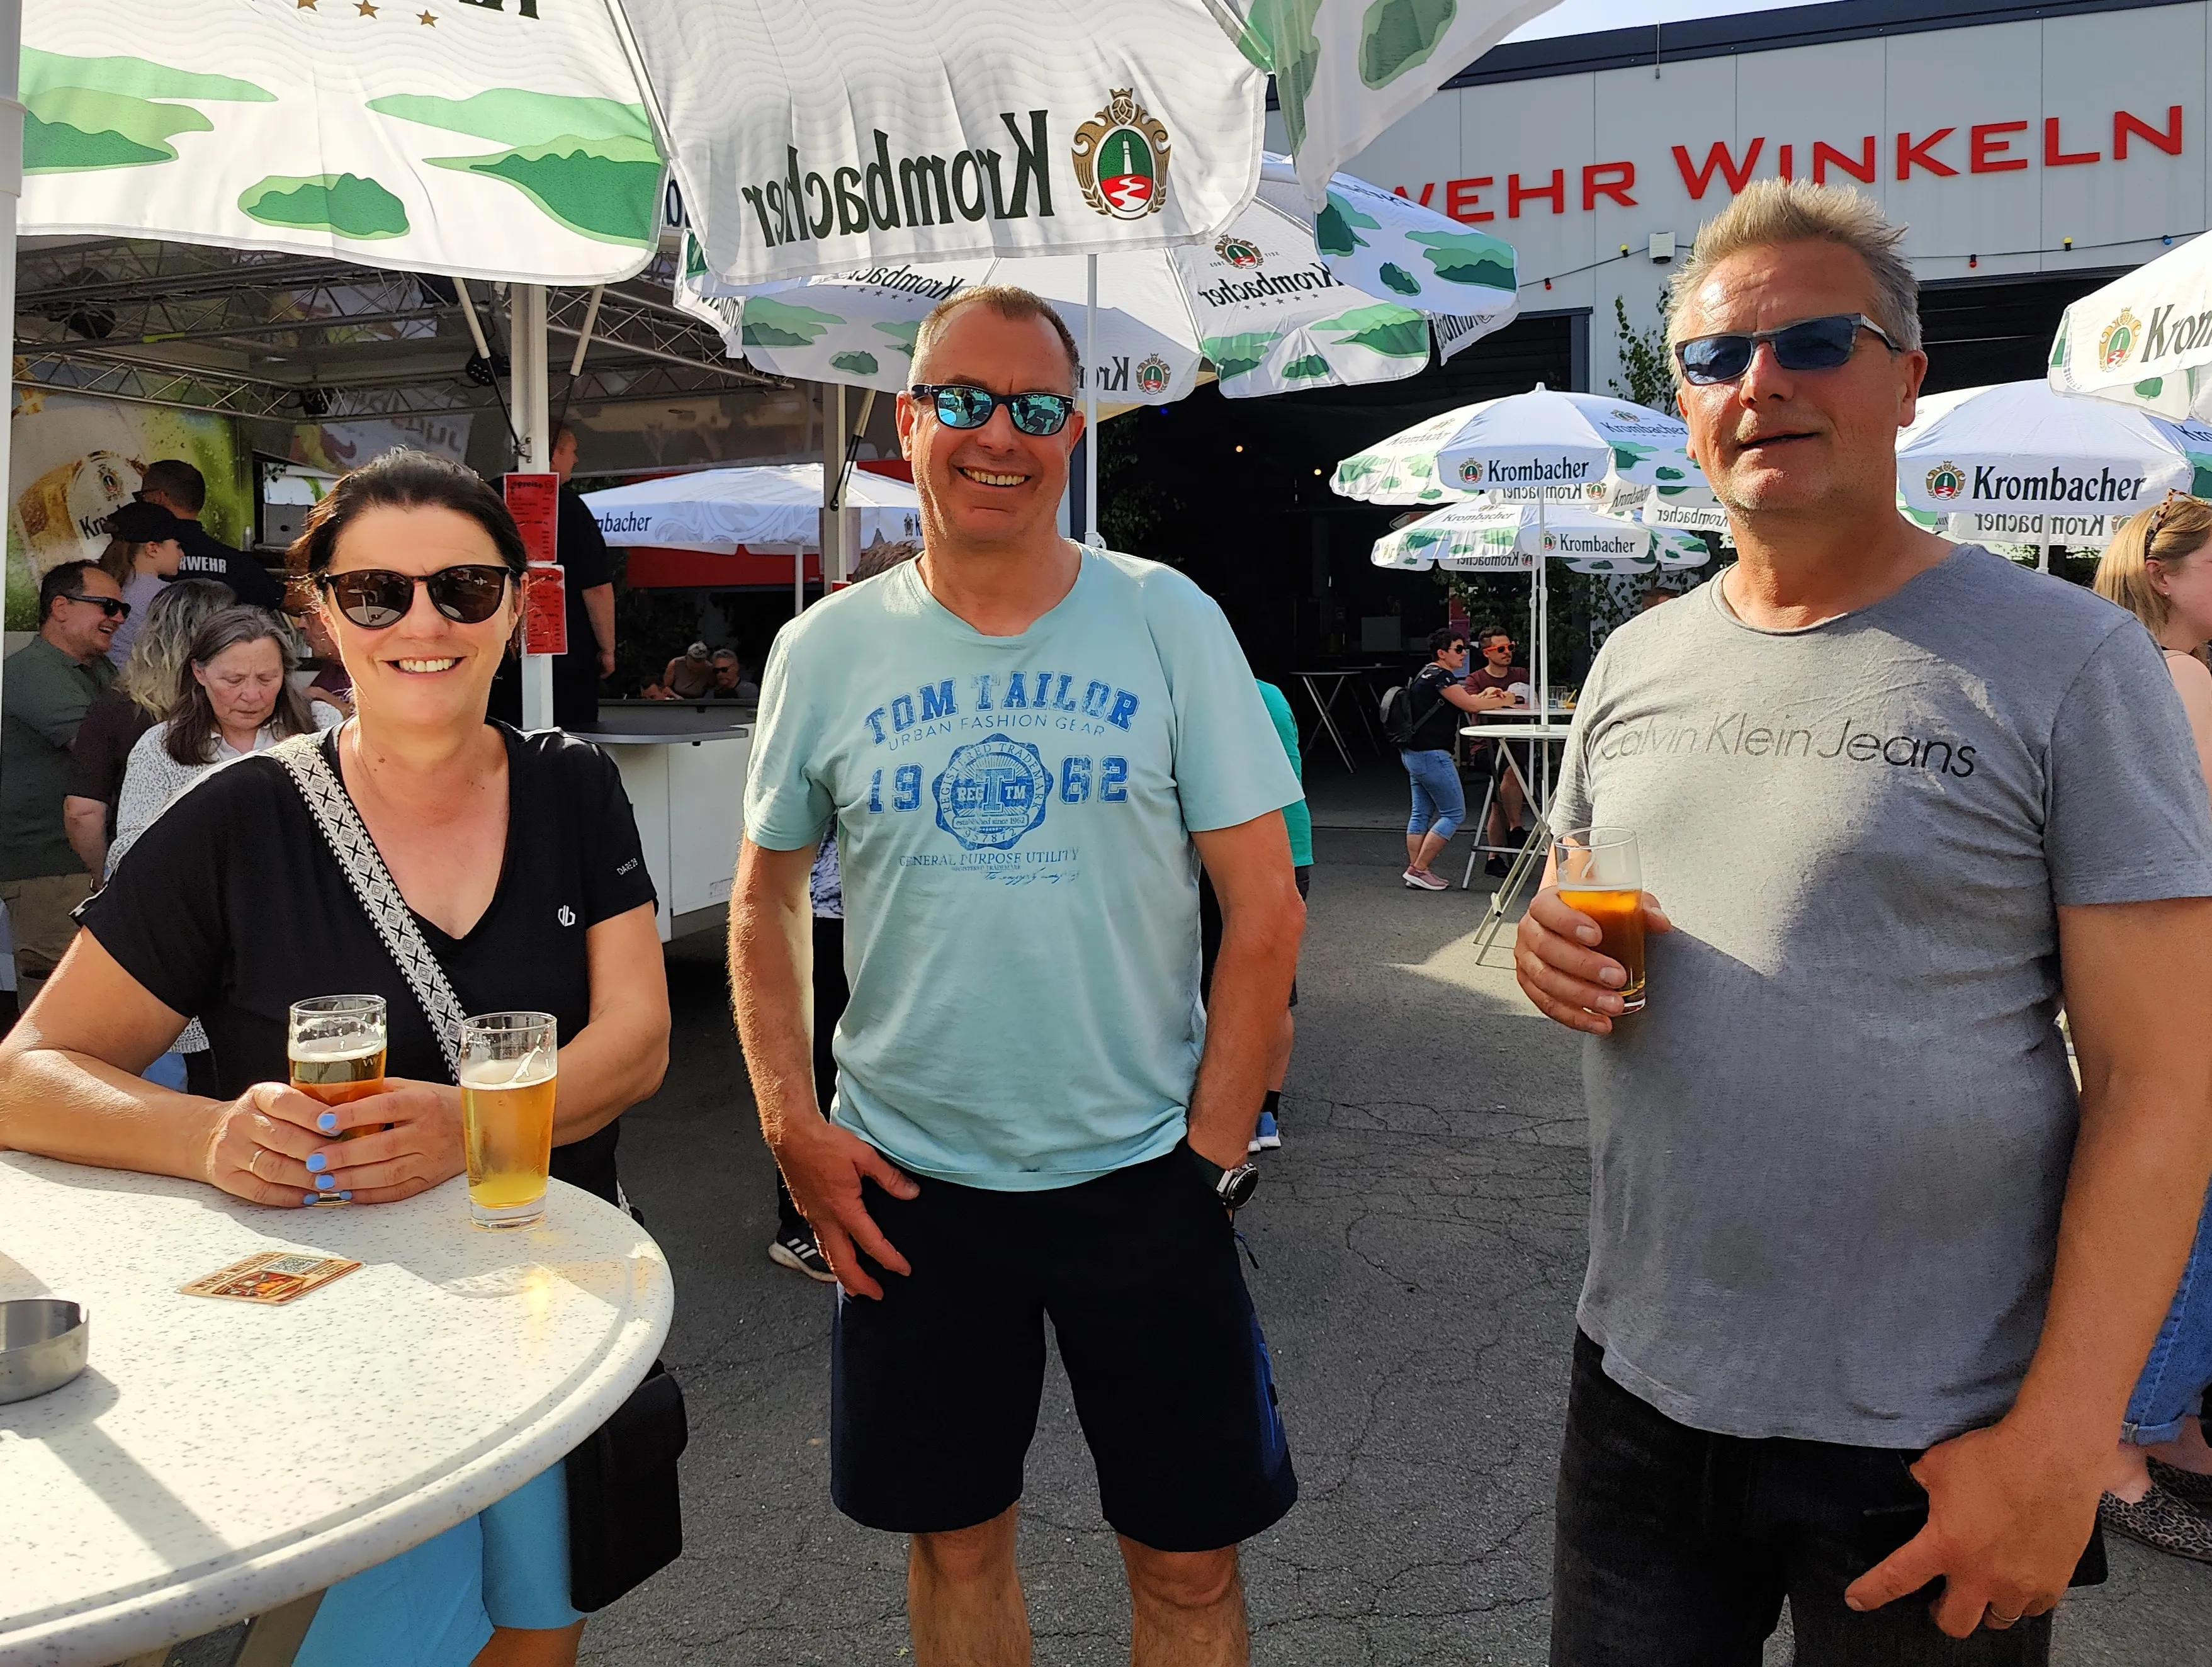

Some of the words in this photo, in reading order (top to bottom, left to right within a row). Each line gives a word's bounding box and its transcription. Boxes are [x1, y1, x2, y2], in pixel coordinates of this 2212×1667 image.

[1393, 161, 1639, 223] EHR
[1671, 105, 2184, 200] WINKELN
[1600, 422, 1689, 436] Krombacher
[1488, 456, 1590, 482] Krombacher
[1972, 465, 2147, 502] Krombacher
[1442, 505, 1516, 523] Krombacher
[1560, 533, 1636, 553] Krombacher
[864, 677, 959, 747] TOM
[971, 670, 1141, 733] TAILOR
[888, 720, 952, 751] URBAN
[961, 713, 1047, 730] FASHION
[1056, 718, 1106, 737] GEAR
[1600, 716, 1698, 760] Calvin
[1705, 711, 1812, 757] Klein
[1816, 718, 1978, 778] Jeans
[867, 762, 924, 815] 19
[1061, 754, 1130, 806] 62
[1005, 784, 1027, 800] TM
